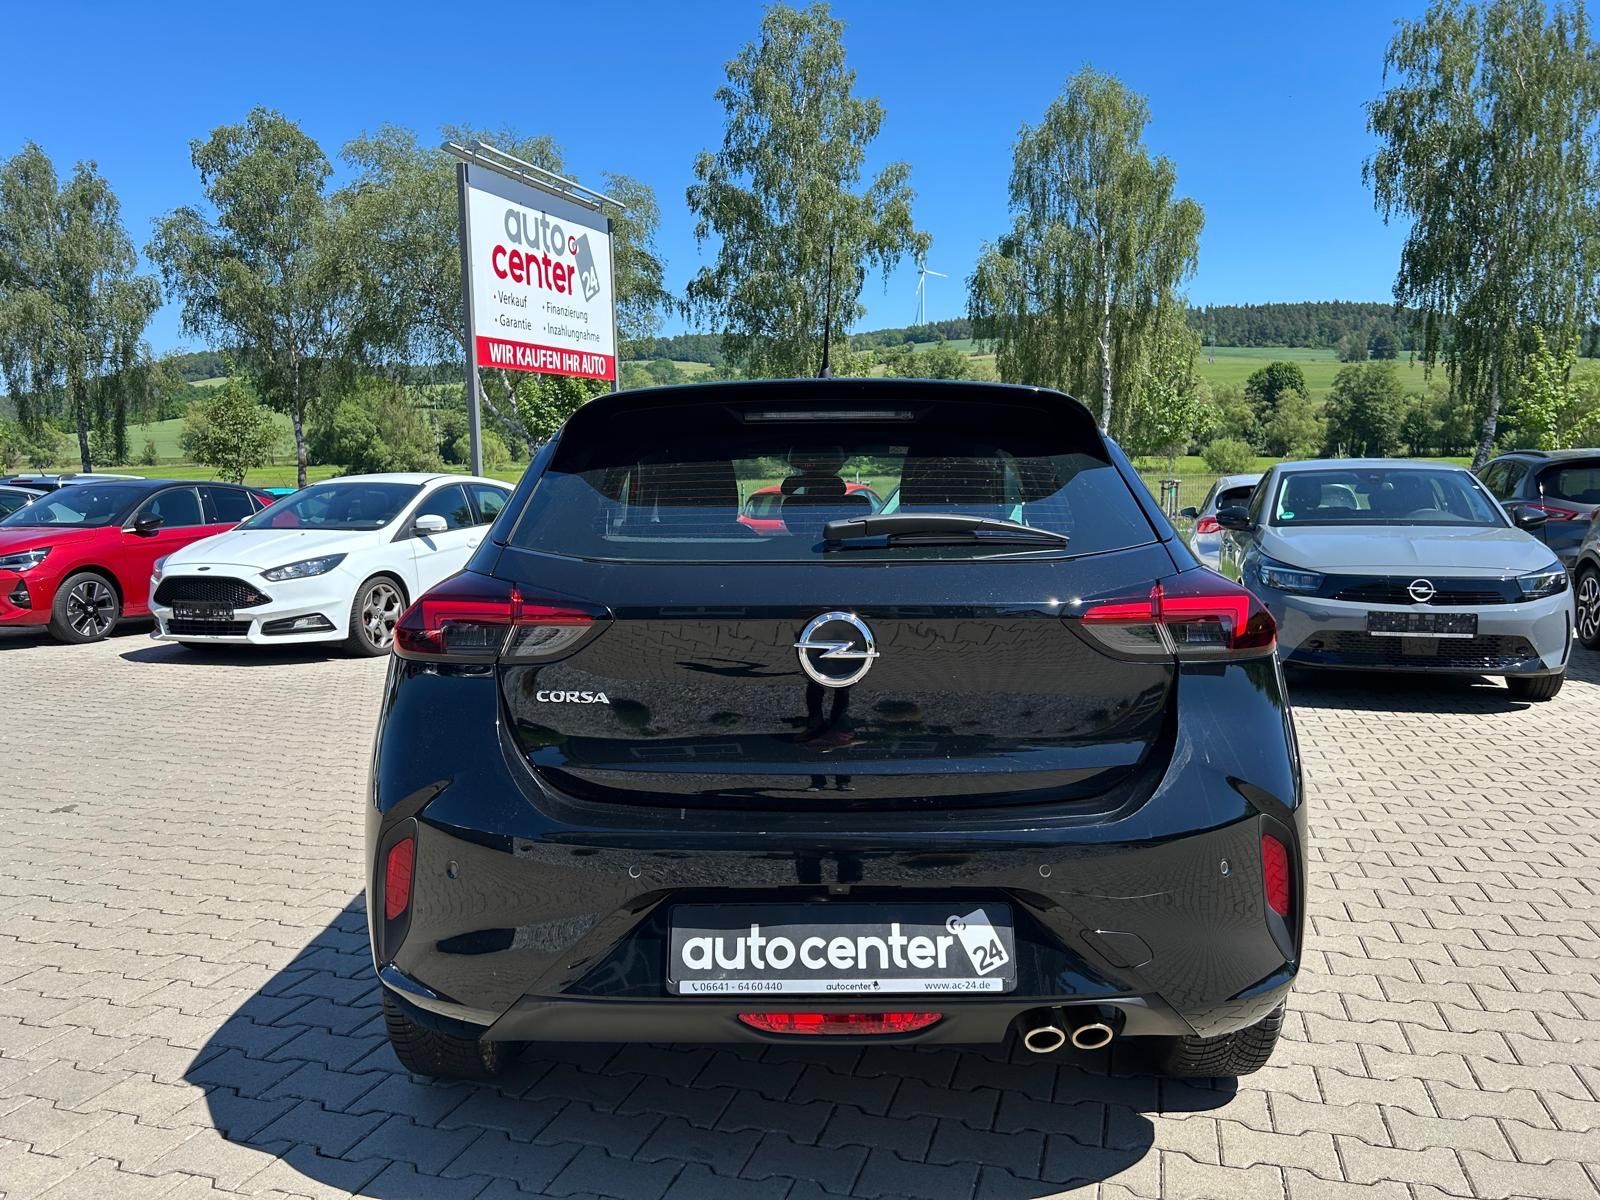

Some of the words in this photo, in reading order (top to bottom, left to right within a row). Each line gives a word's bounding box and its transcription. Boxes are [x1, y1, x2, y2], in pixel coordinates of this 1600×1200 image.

[504, 208, 565, 257] auto
[492, 245, 575, 295] center
[582, 267, 598, 297] 24
[498, 290, 527, 308] Verkauf
[500, 314, 532, 330] Garantie
[546, 302, 588, 323] Finanzierung
[548, 323, 600, 342] Inzahlungnahme
[489, 343, 514, 364] WIR
[516, 347, 561, 369] KAUFEN
[563, 353, 580, 372] IHR
[582, 355, 606, 375] AUTO
[536, 690, 610, 704] CORSA
[972, 938, 1004, 971] 24
[700, 982, 729, 991] 06641
[826, 981, 871, 991] autocenter
[924, 981, 991, 991] www.ac-24.de
